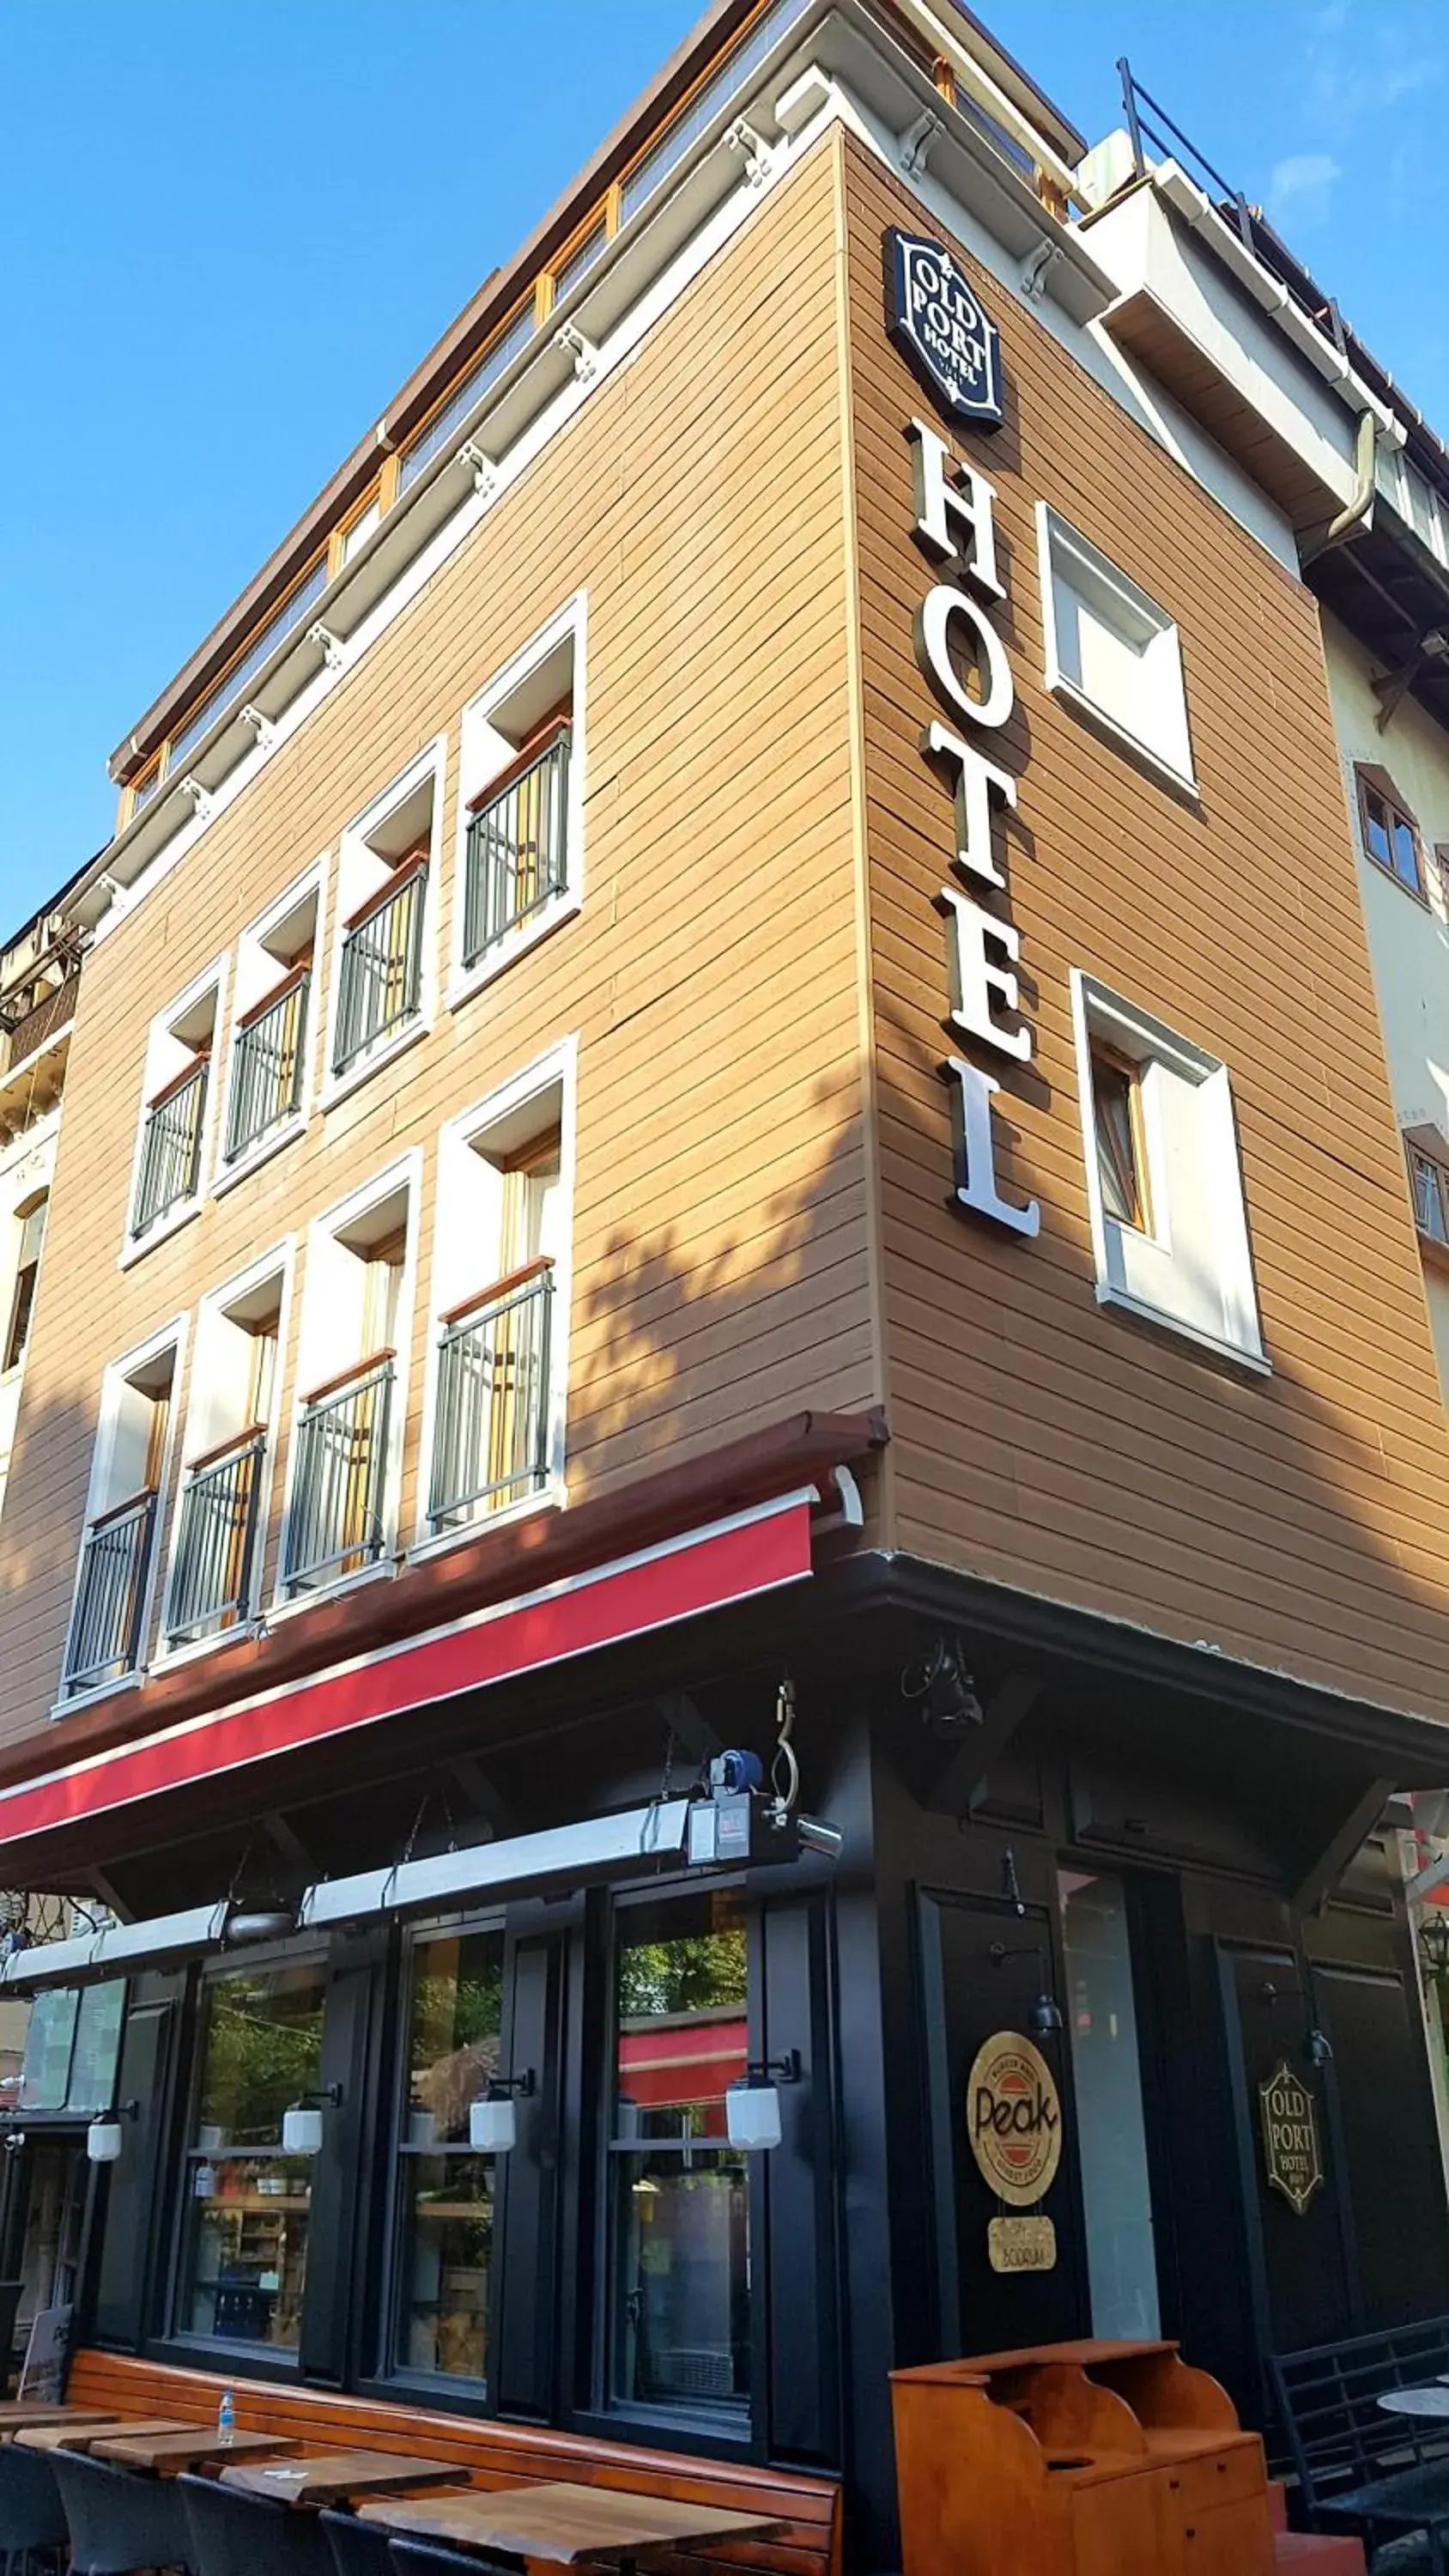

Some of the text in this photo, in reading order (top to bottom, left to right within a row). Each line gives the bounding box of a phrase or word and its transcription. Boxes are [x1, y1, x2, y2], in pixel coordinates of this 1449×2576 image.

[915, 258, 978, 331] OLD
[912, 280, 985, 372] PORT
[925, 323, 979, 386] HOTEL
[910, 416, 1041, 1237] HOTEL
[975, 2081, 1058, 2139] Peak
[1271, 2090, 1305, 2117] OLD
[1271, 2123, 1313, 2151] PORT
[1280, 2154, 1309, 2172] HOTEL
